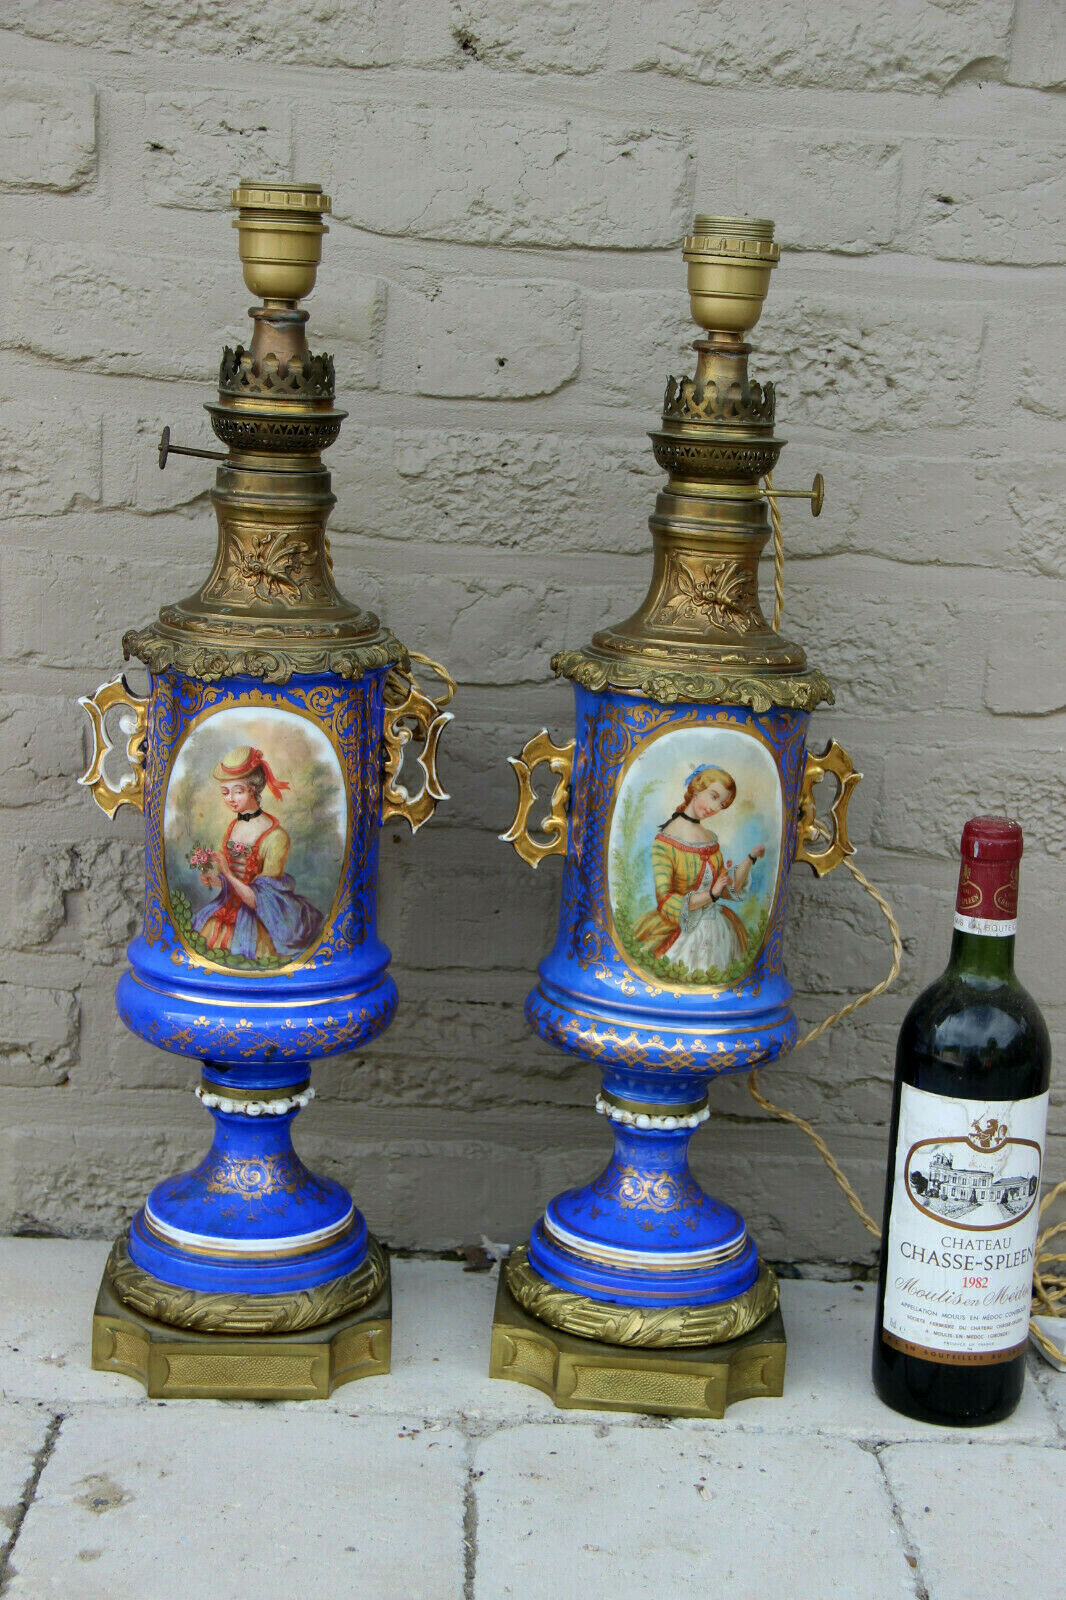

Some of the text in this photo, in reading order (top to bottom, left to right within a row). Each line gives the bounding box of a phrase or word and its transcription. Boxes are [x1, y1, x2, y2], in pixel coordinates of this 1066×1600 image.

[941, 1236, 1012, 1251] CHATEAU
[900, 1241, 1034, 1271] CHASSE-SPLEEN
[894, 1276, 962, 1305] Moulis
[963, 1298, 980, 1307] en
[962, 1276, 989, 1289] 1982
